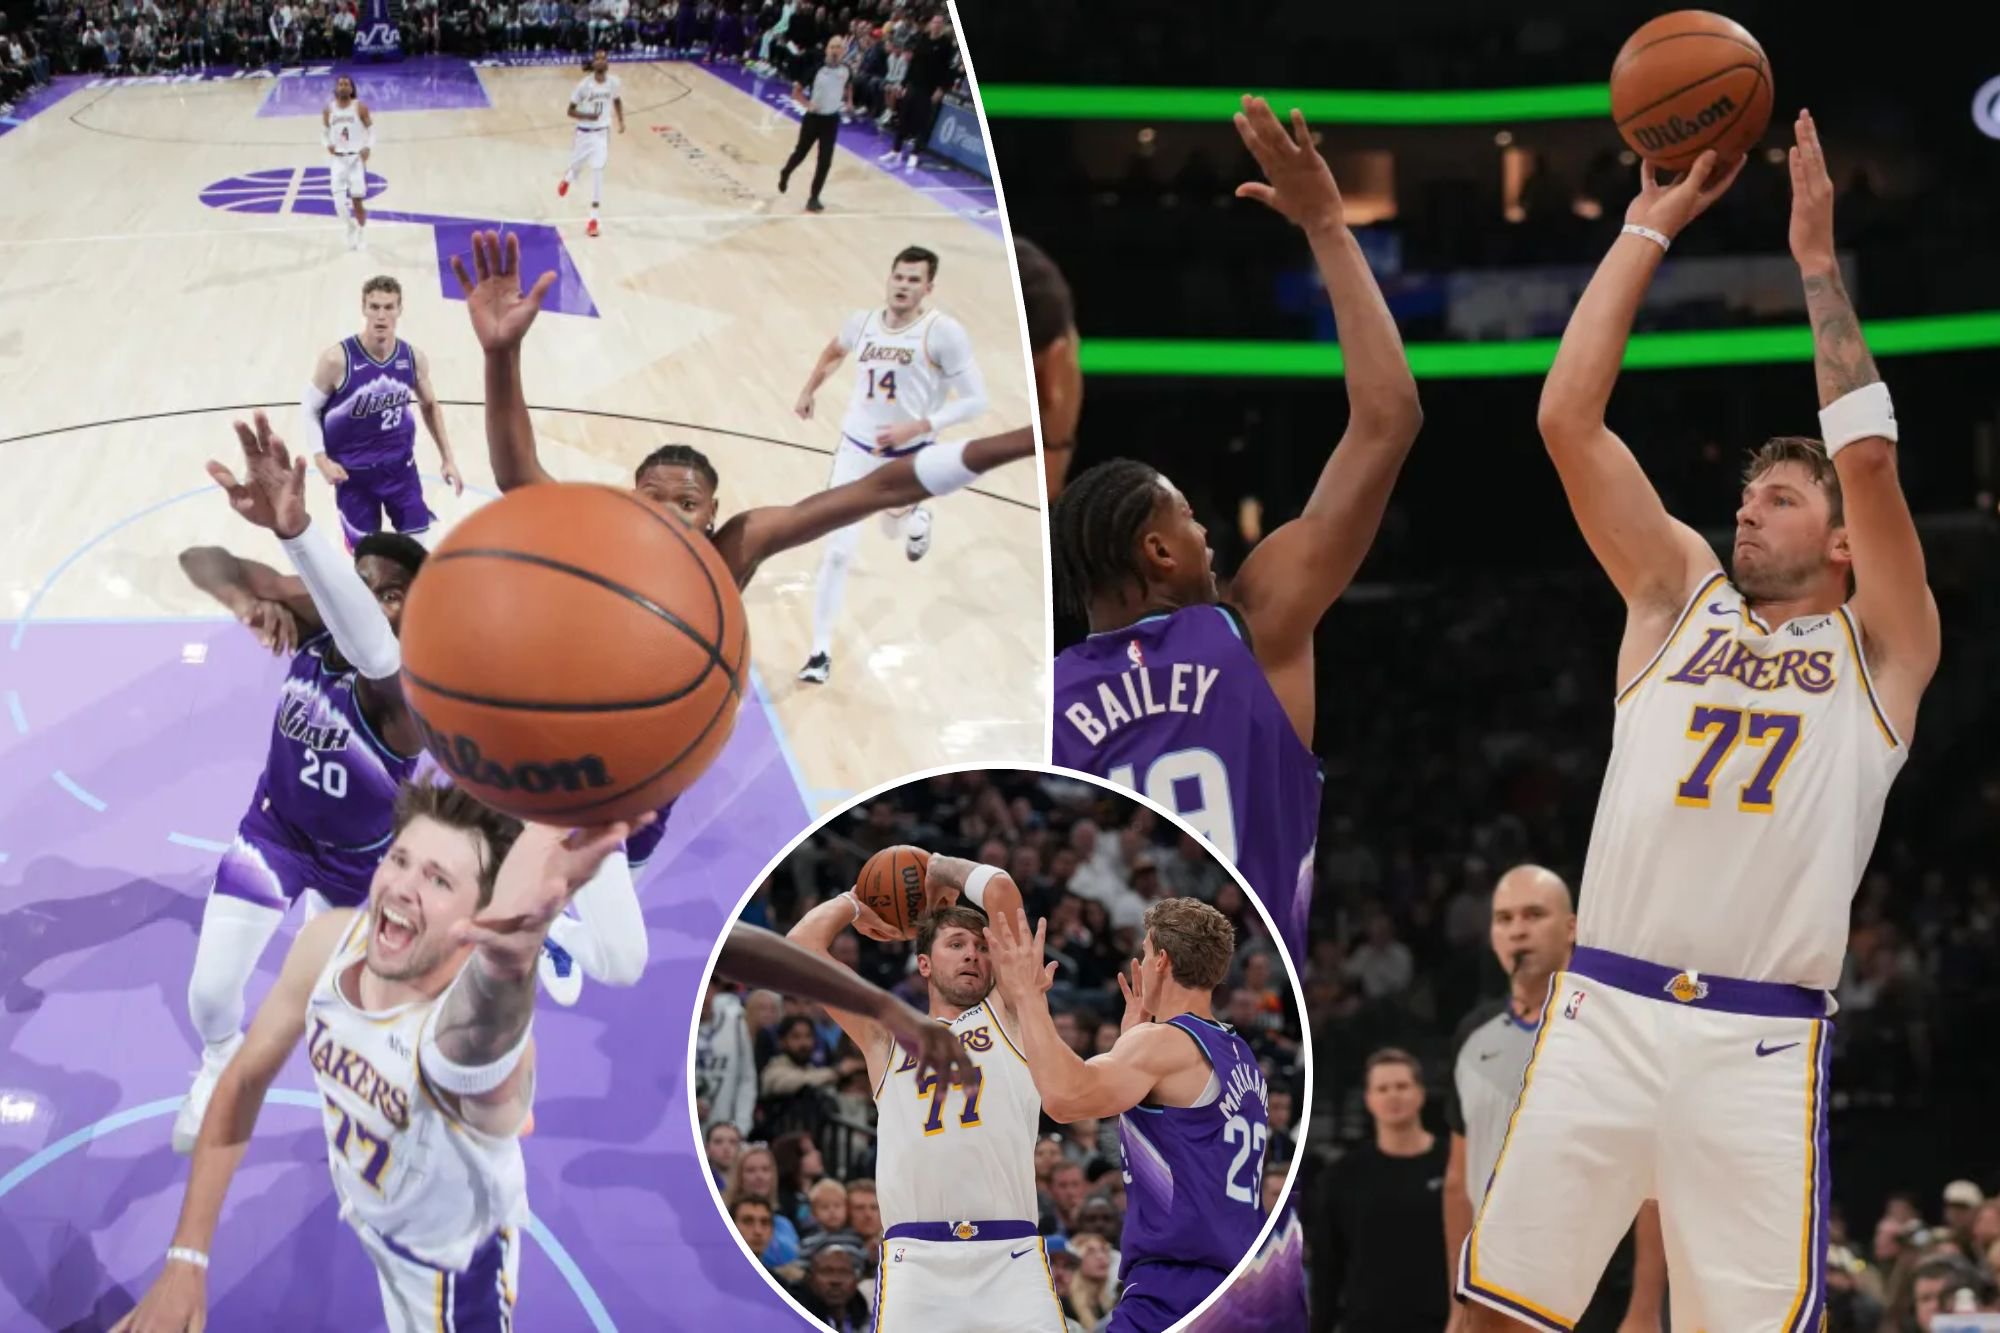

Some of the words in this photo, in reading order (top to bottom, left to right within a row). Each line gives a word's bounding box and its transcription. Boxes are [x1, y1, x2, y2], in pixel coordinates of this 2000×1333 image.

[339, 126, 350, 143] 4
[1632, 95, 1735, 151] Wilson
[859, 342, 915, 366] LAKERS
[866, 368, 897, 405] 14
[381, 406, 402, 430] 23
[1665, 627, 1839, 695] LAKERS
[278, 690, 351, 752] UTAH
[1065, 662, 1220, 746] BAILEY
[300, 748, 348, 799] 20
[1674, 703, 1805, 816] 77
[1107, 746, 1238, 867] 9
[309, 1016, 410, 1131] LAKERS
[917, 1065, 985, 1137] 77
[324, 1092, 393, 1192] 77
[1223, 1114, 1267, 1211] 23
